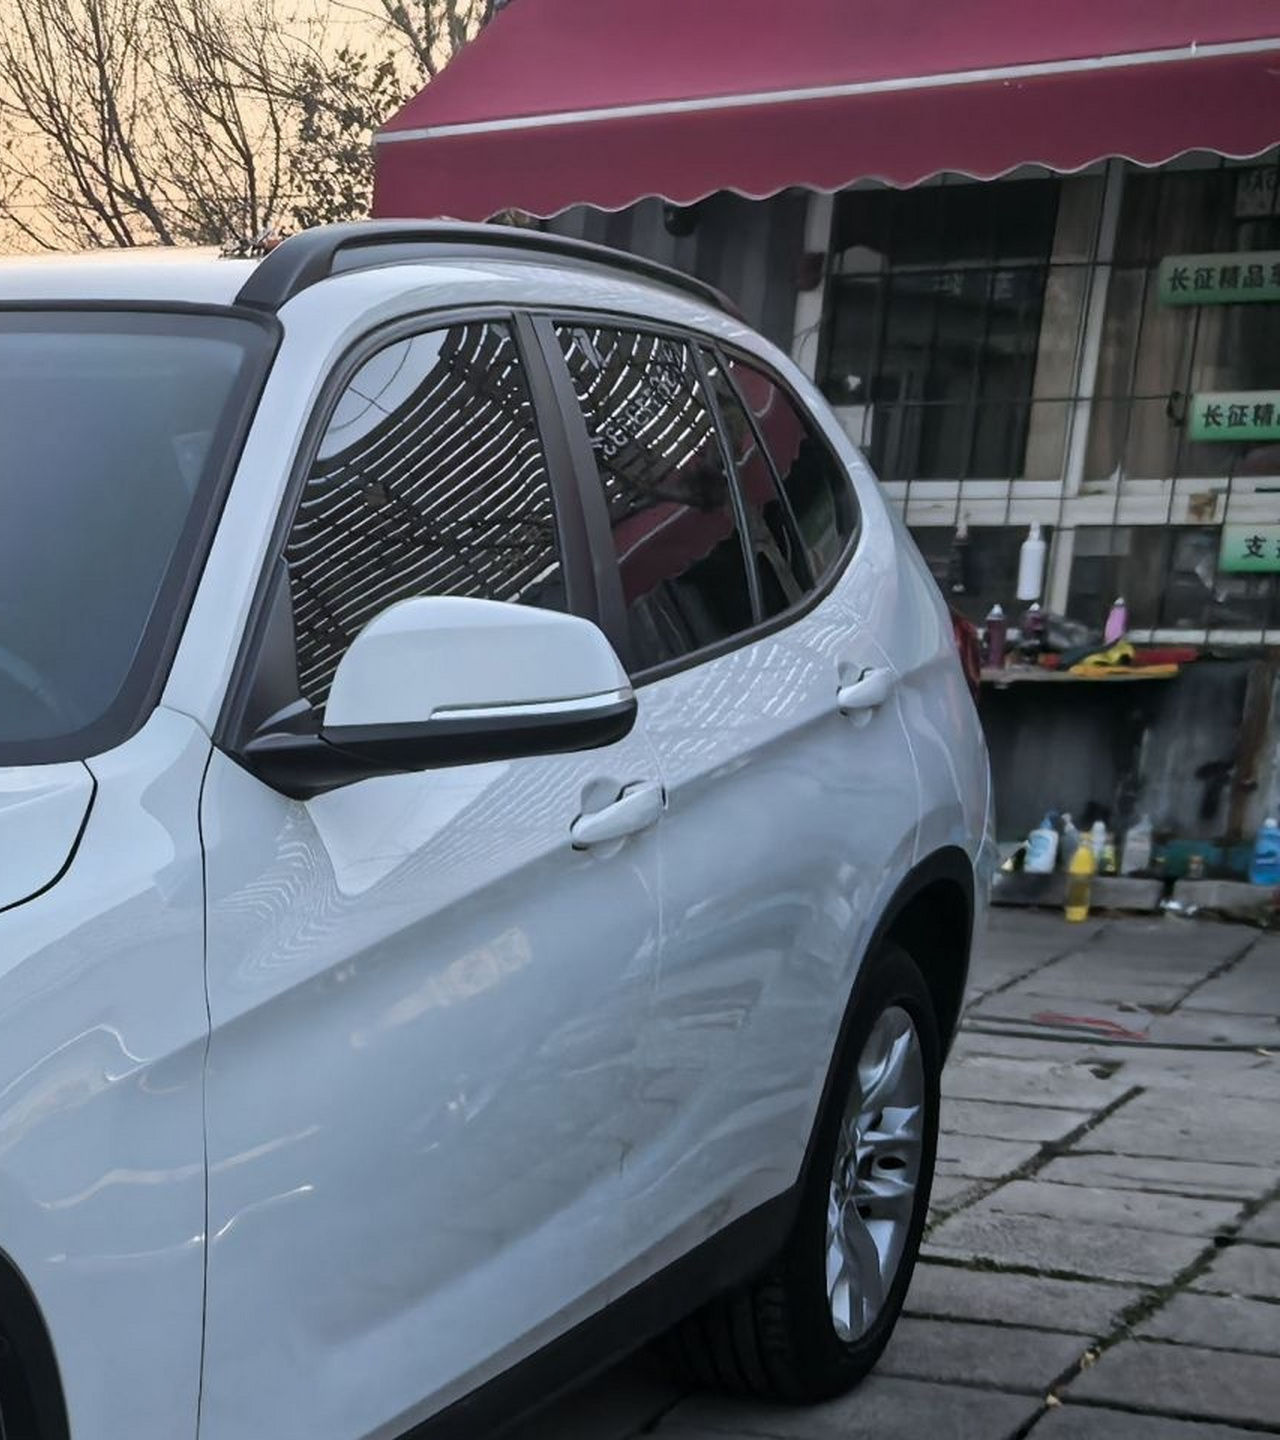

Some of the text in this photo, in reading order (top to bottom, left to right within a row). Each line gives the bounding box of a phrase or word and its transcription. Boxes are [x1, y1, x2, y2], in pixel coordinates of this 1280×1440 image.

[1202, 403, 1280, 428] 长征精
[1242, 534, 1280, 559] 支
